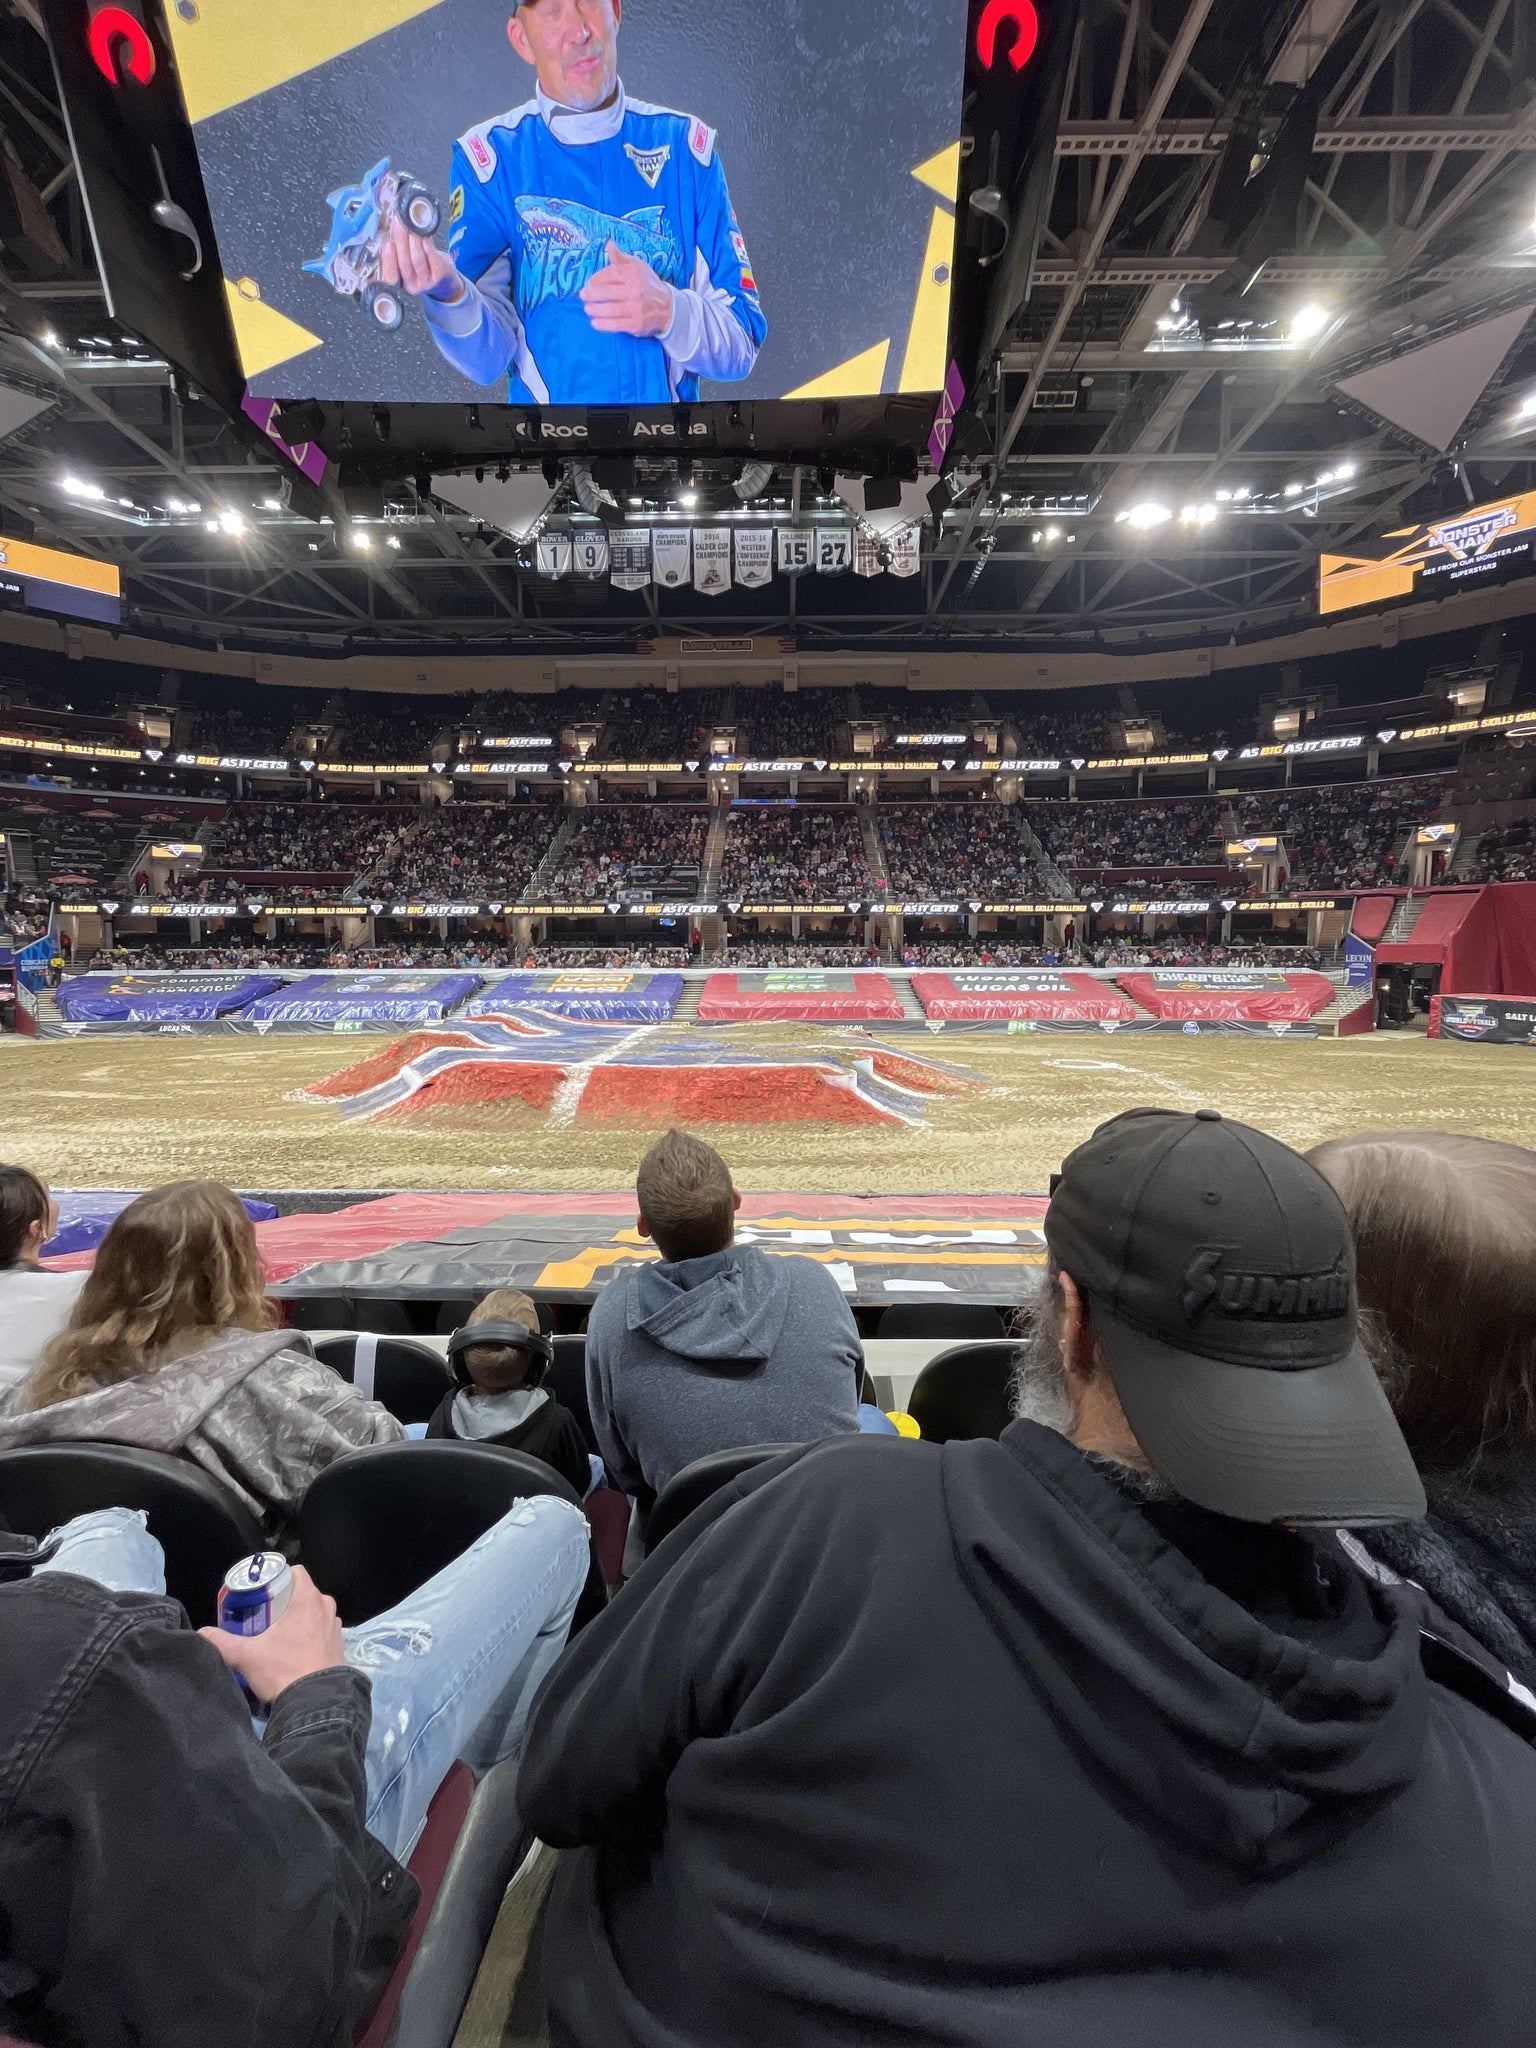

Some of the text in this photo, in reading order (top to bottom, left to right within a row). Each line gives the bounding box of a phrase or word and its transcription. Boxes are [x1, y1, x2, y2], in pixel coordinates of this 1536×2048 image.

[519, 238, 684, 314] MEGAON
[541, 421, 708, 438] Roc Area
[1428, 513, 1518, 548] MONSTER
[1453, 530, 1496, 551] JAM
[550, 546, 557, 568] 1
[585, 546, 596, 567] 9
[696, 551, 729, 559] CHAMPIONS
[784, 543, 808, 565] 15
[821, 542, 847, 565] 27
[1460, 557, 1475, 567] OUR
[1450, 562, 1498, 579] SUPERSTARS
[1504, 1012, 1528, 1021] SALT
